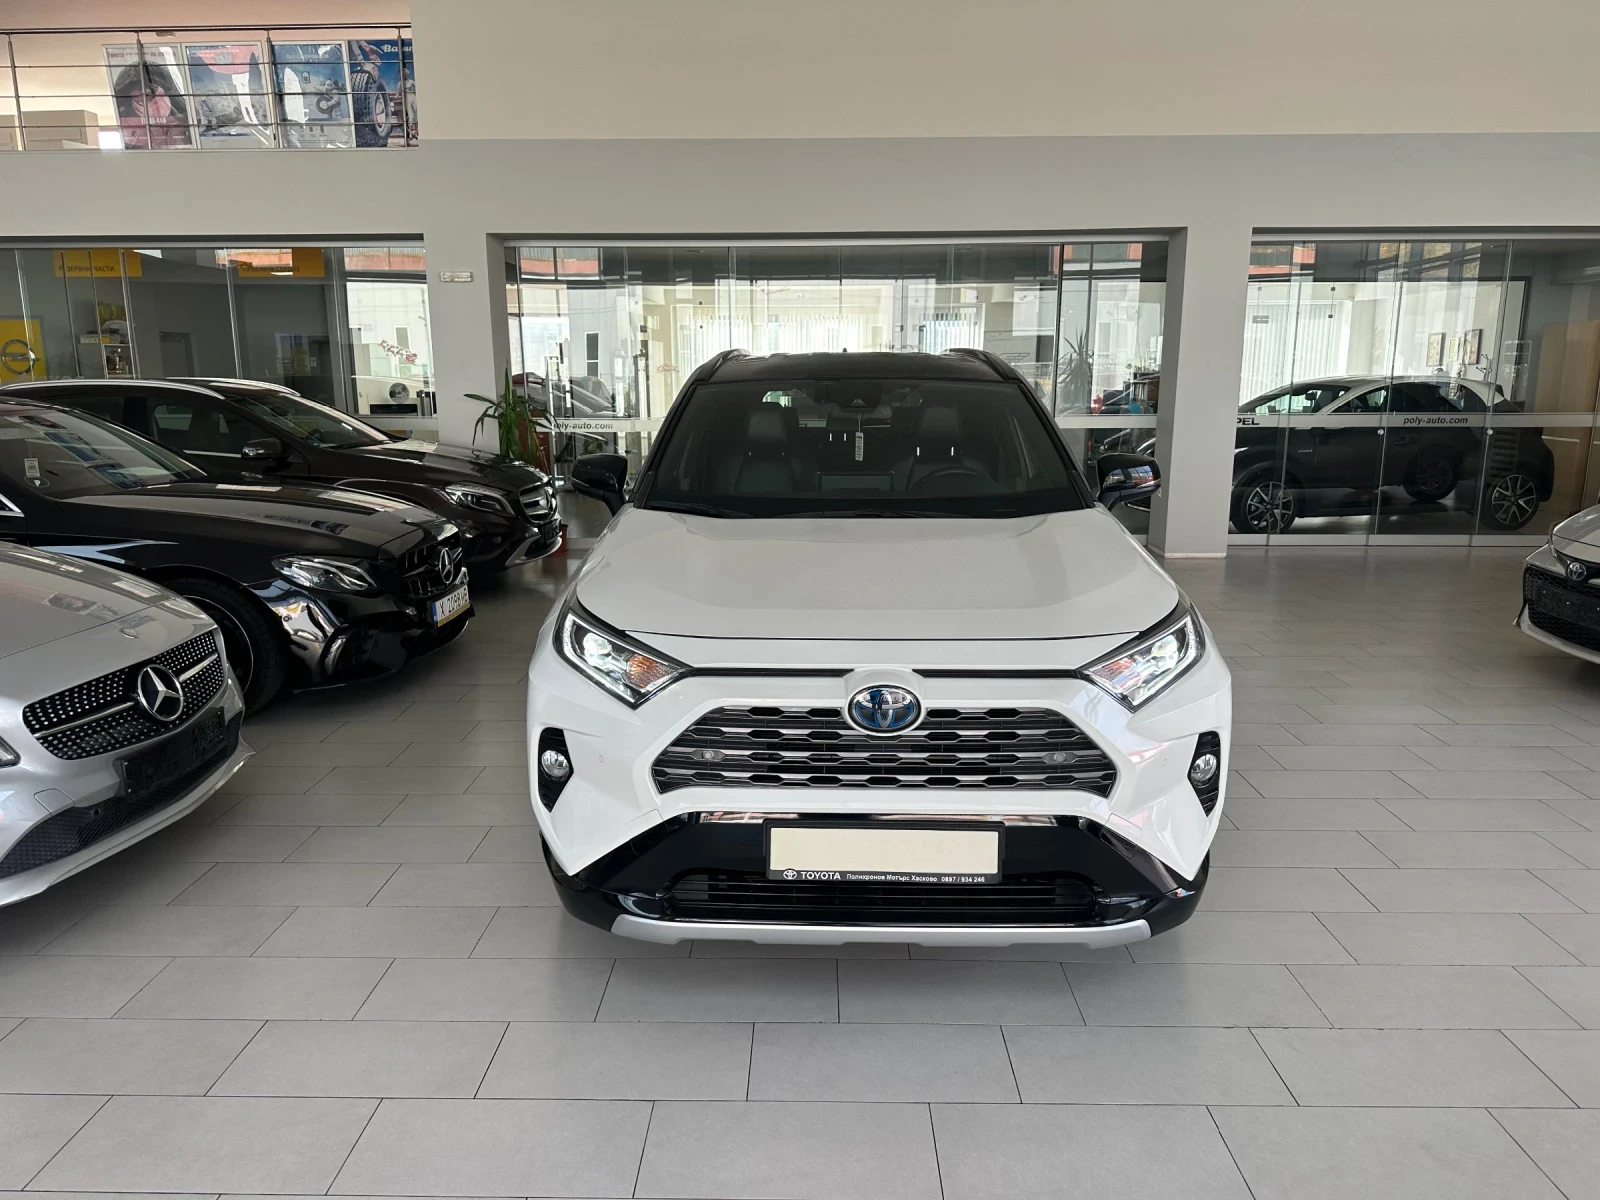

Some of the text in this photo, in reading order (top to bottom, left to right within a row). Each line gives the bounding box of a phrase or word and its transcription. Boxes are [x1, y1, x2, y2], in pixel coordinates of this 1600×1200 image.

[384, 44, 413, 52] Bau
[1403, 416, 1468, 425] poly-auto.com
[800, 871, 841, 880] TOYOTA
[846, 873, 886, 881] Полихронов
[886, 874, 910, 882] Мотърс
